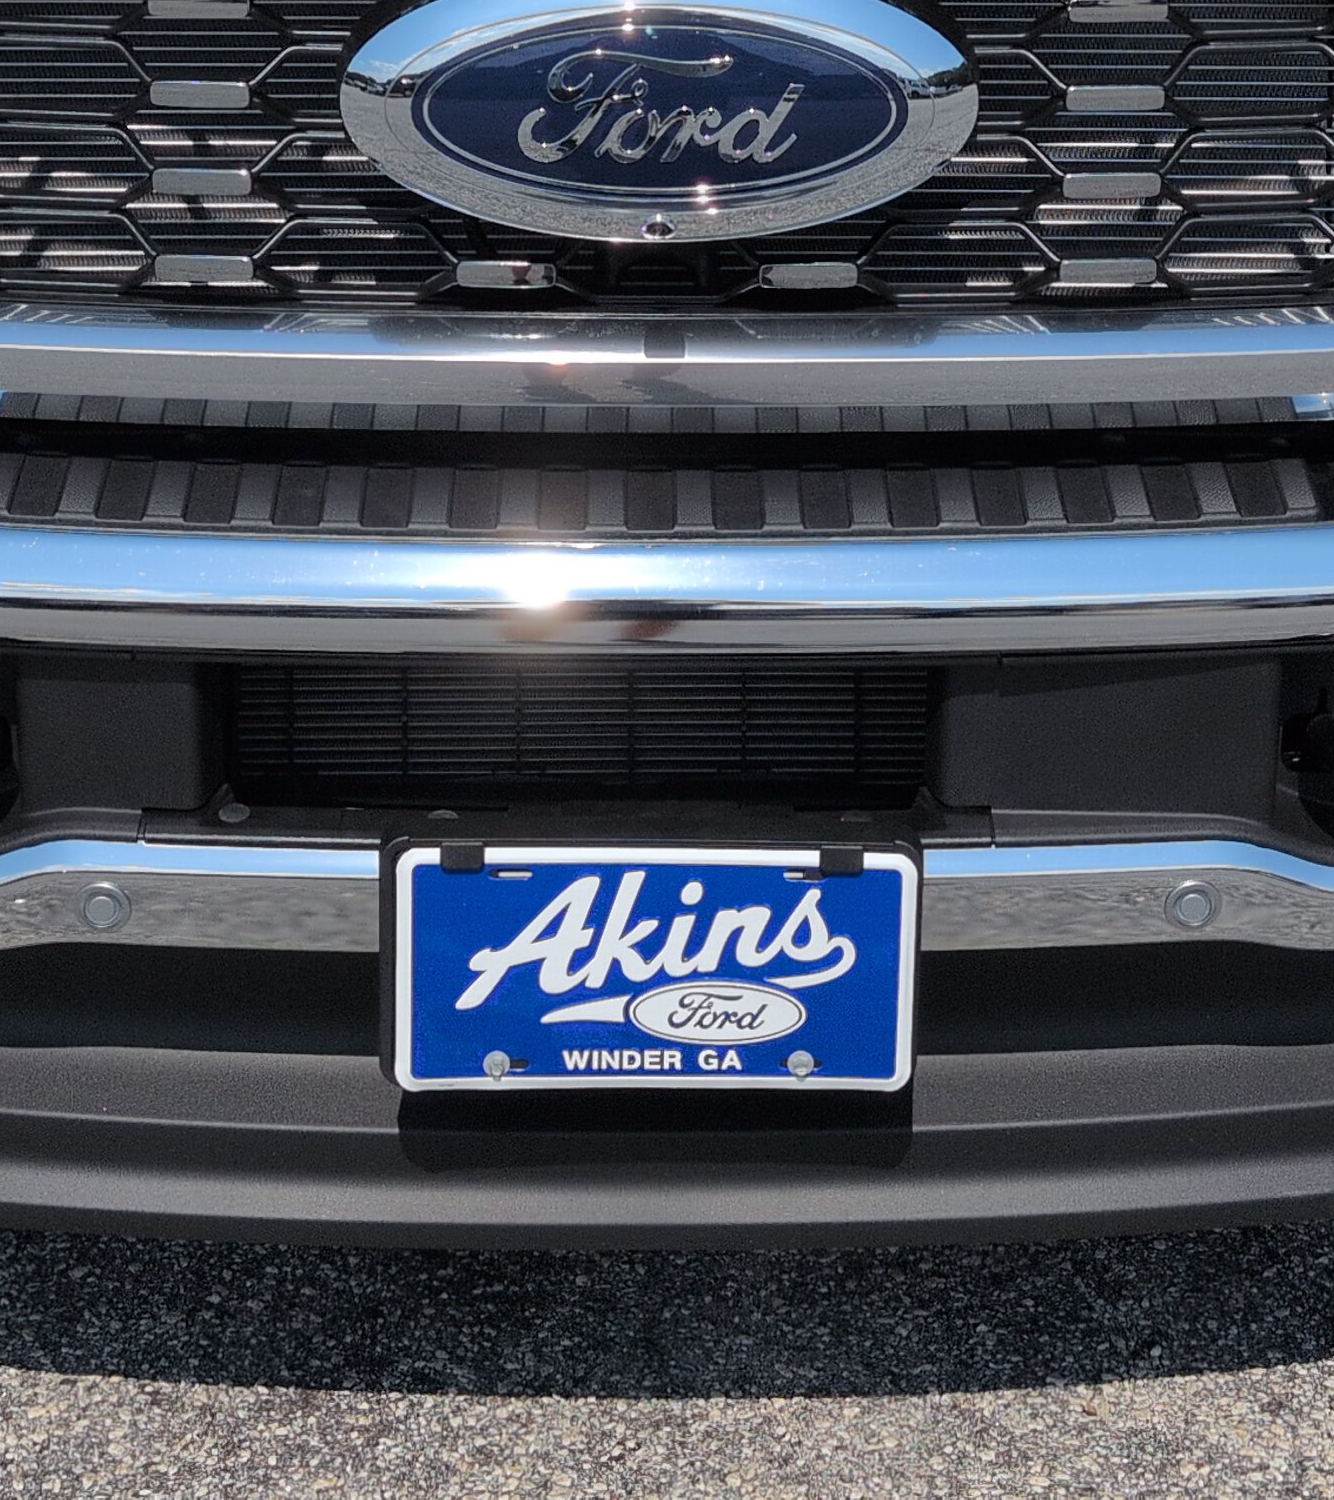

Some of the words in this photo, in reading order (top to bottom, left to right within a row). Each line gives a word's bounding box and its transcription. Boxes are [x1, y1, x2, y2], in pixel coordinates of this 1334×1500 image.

[517, 49, 806, 164] Ford
[455, 870, 857, 1010] Akins
[667, 992, 769, 1030] Ford
[562, 1049, 683, 1071] WINDER
[697, 1049, 743, 1071] GA
